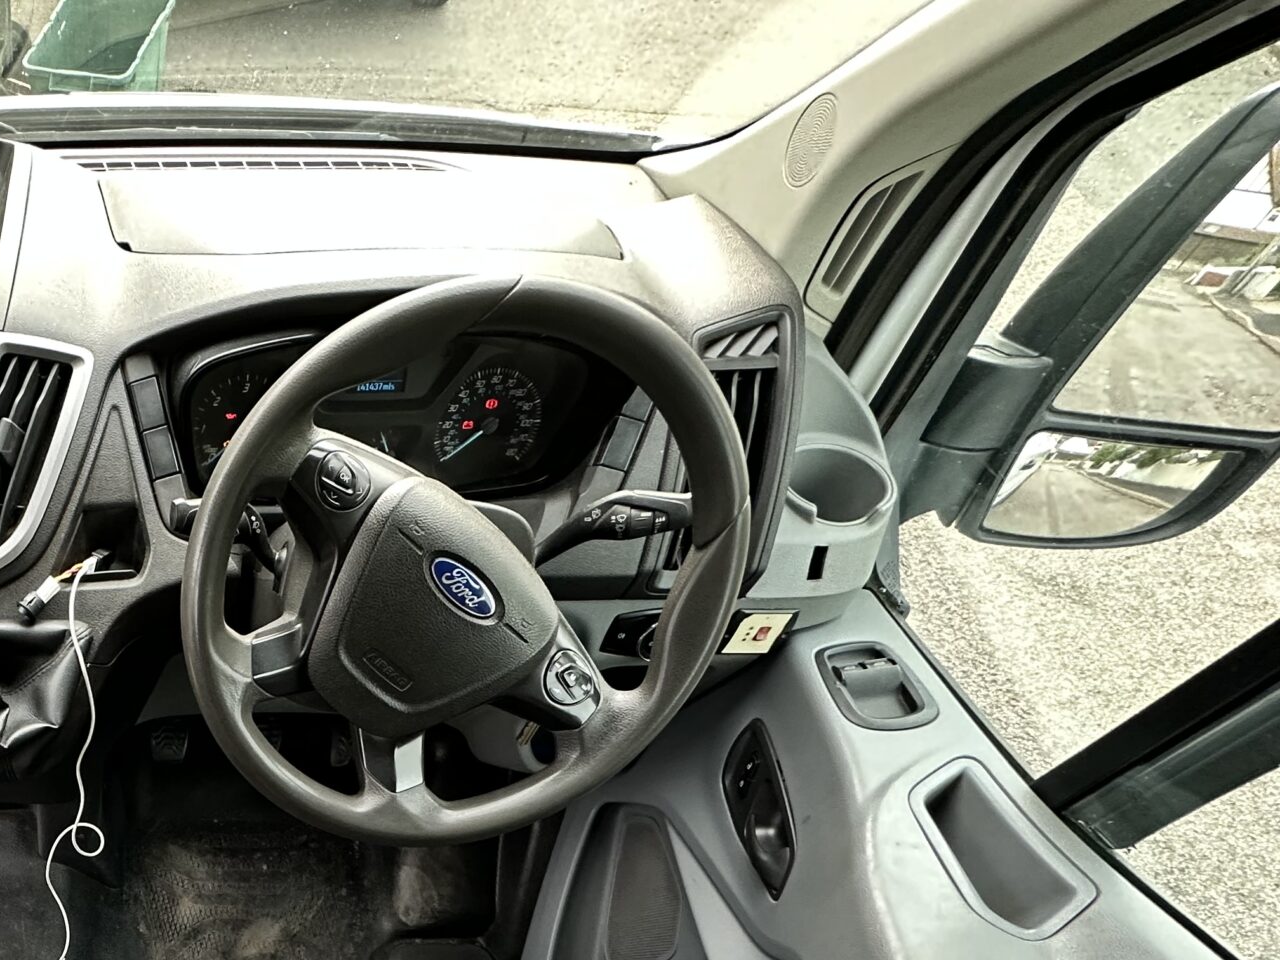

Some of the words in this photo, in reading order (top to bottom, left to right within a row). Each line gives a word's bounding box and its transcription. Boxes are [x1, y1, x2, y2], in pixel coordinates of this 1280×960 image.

[242, 383, 251, 393] 3
[213, 396, 221, 407] 2
[442, 420, 454, 428] 20
[340, 472, 350, 484] OK
[441, 568, 486, 608] Ford
